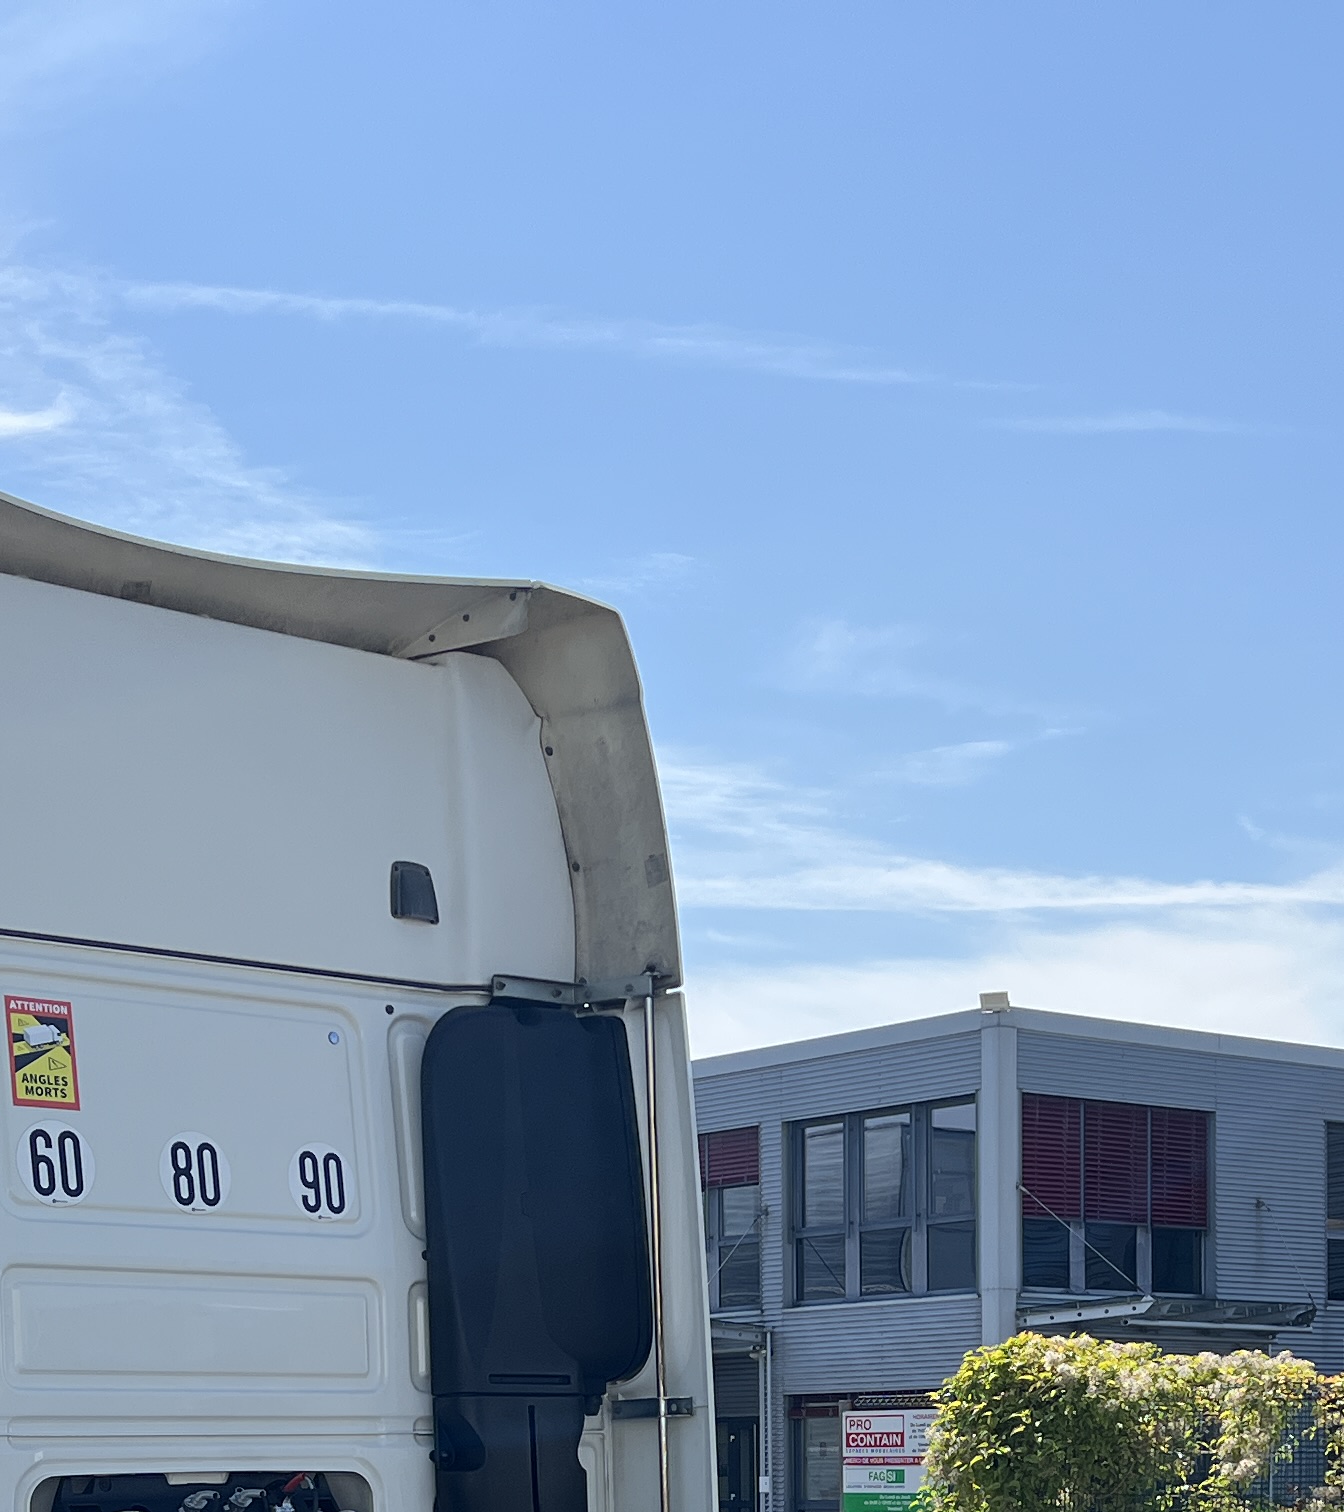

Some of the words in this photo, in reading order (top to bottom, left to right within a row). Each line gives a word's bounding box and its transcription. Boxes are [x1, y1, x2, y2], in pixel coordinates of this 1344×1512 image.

[9, 1000, 68, 1015] ATTENTION
[21, 1073, 69, 1087] ANGLES
[25, 1085, 68, 1099] MORTS
[29, 1128, 84, 1198] 60
[171, 1141, 221, 1207] 80
[299, 1151, 346, 1215] 90
[849, 1419, 872, 1431] PRO
[849, 1433, 901, 1446] CONTAIN
